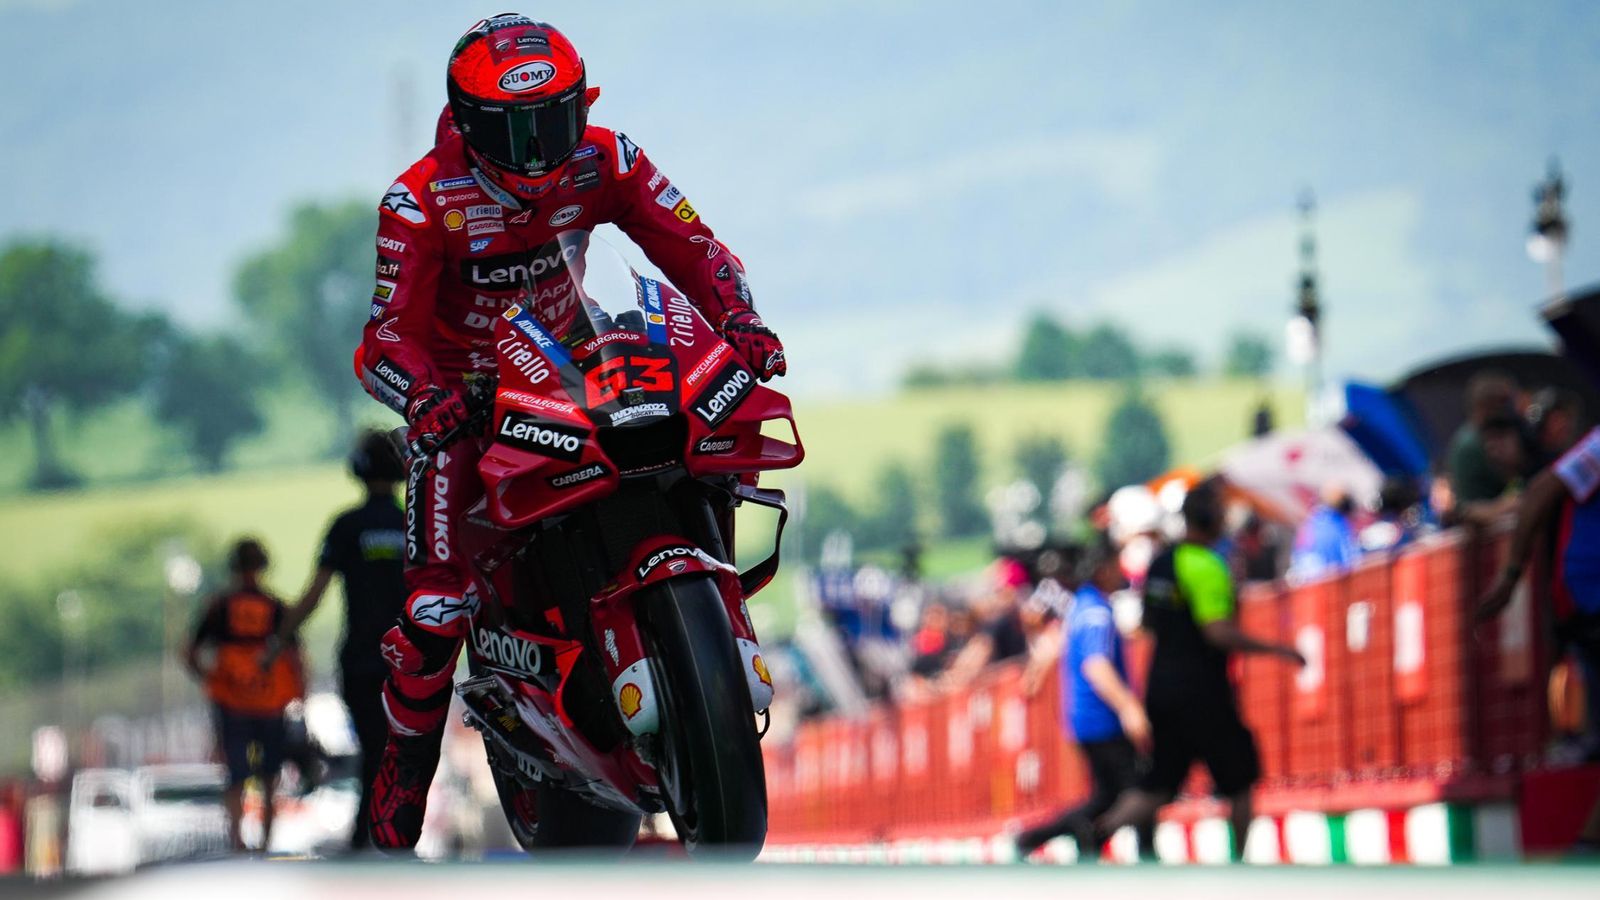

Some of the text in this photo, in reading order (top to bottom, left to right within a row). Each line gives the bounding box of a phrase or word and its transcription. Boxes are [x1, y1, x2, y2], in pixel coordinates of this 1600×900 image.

[503, 69, 551, 85] SUOMY
[444, 179, 474, 187] MICHELIN
[574, 171, 598, 181] Lenovo
[447, 192, 479, 202] motorola
[476, 206, 501, 215] riello
[470, 240, 489, 252] SAP
[472, 245, 577, 284] Lenovo
[667, 297, 694, 337] riello
[515, 320, 554, 349] ADVANCE
[584, 332, 640, 352] VARGROUP
[375, 360, 409, 391] Lenovo
[502, 341, 550, 384] riello
[687, 342, 729, 386] FRECCIAROSSA
[584, 355, 675, 410] 63
[697, 369, 750, 422] Lenovo
[500, 391, 575, 414] FRECCIAROSSA
[609, 402, 669, 421] WDW2022
[500, 416, 580, 452] Lenovo
[700, 440, 734, 451] CARRERA
[552, 465, 604, 487] CARRERA
[434, 474, 450, 561] DAIKO
[469, 615, 541, 675] Lenovo
